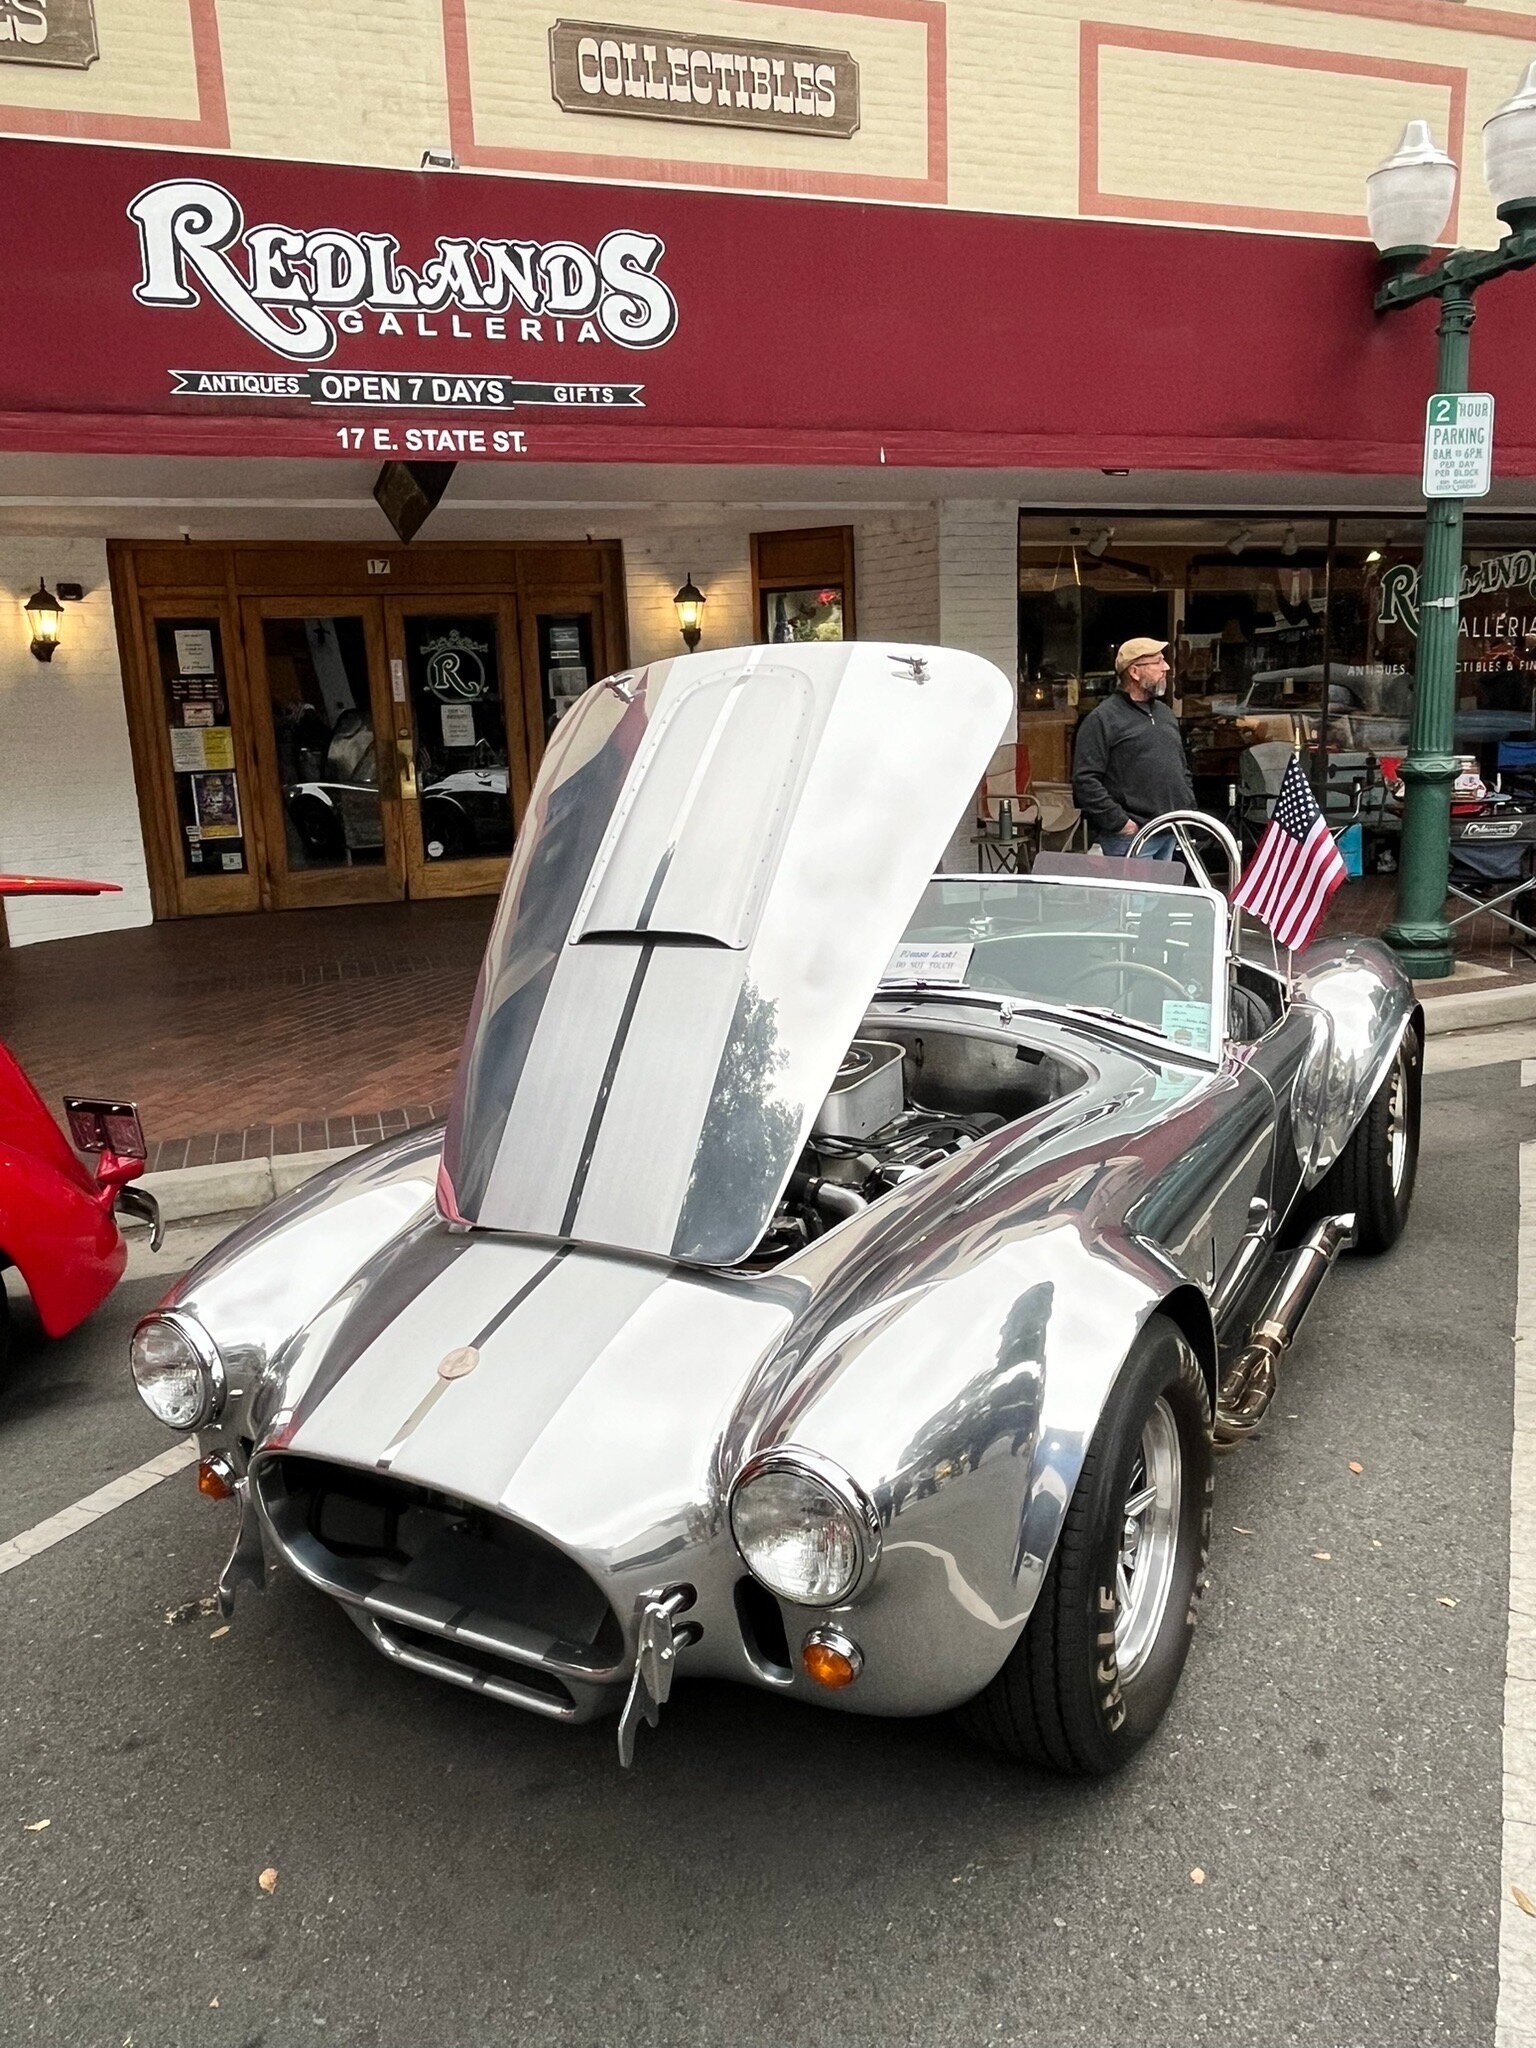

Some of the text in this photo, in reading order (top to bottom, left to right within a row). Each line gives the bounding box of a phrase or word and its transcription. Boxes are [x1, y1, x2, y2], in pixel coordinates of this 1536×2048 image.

[577, 37, 836, 118] COLLECTIBLES
[126, 178, 679, 362] REDLANDS
[337, 310, 601, 343] GALLERIA
[198, 374, 300, 394] ANTIQUES
[320, 375, 505, 404] OPEN 7 DAYS
[553, 386, 614, 403] GIFTS
[1436, 399, 1488, 422] 2 HOUR
[336, 427, 528, 453] 17 E. STATE ST.
[1433, 427, 1485, 446] PARKING
[370, 560, 389, 573] 17
[433, 652, 480, 698] R
